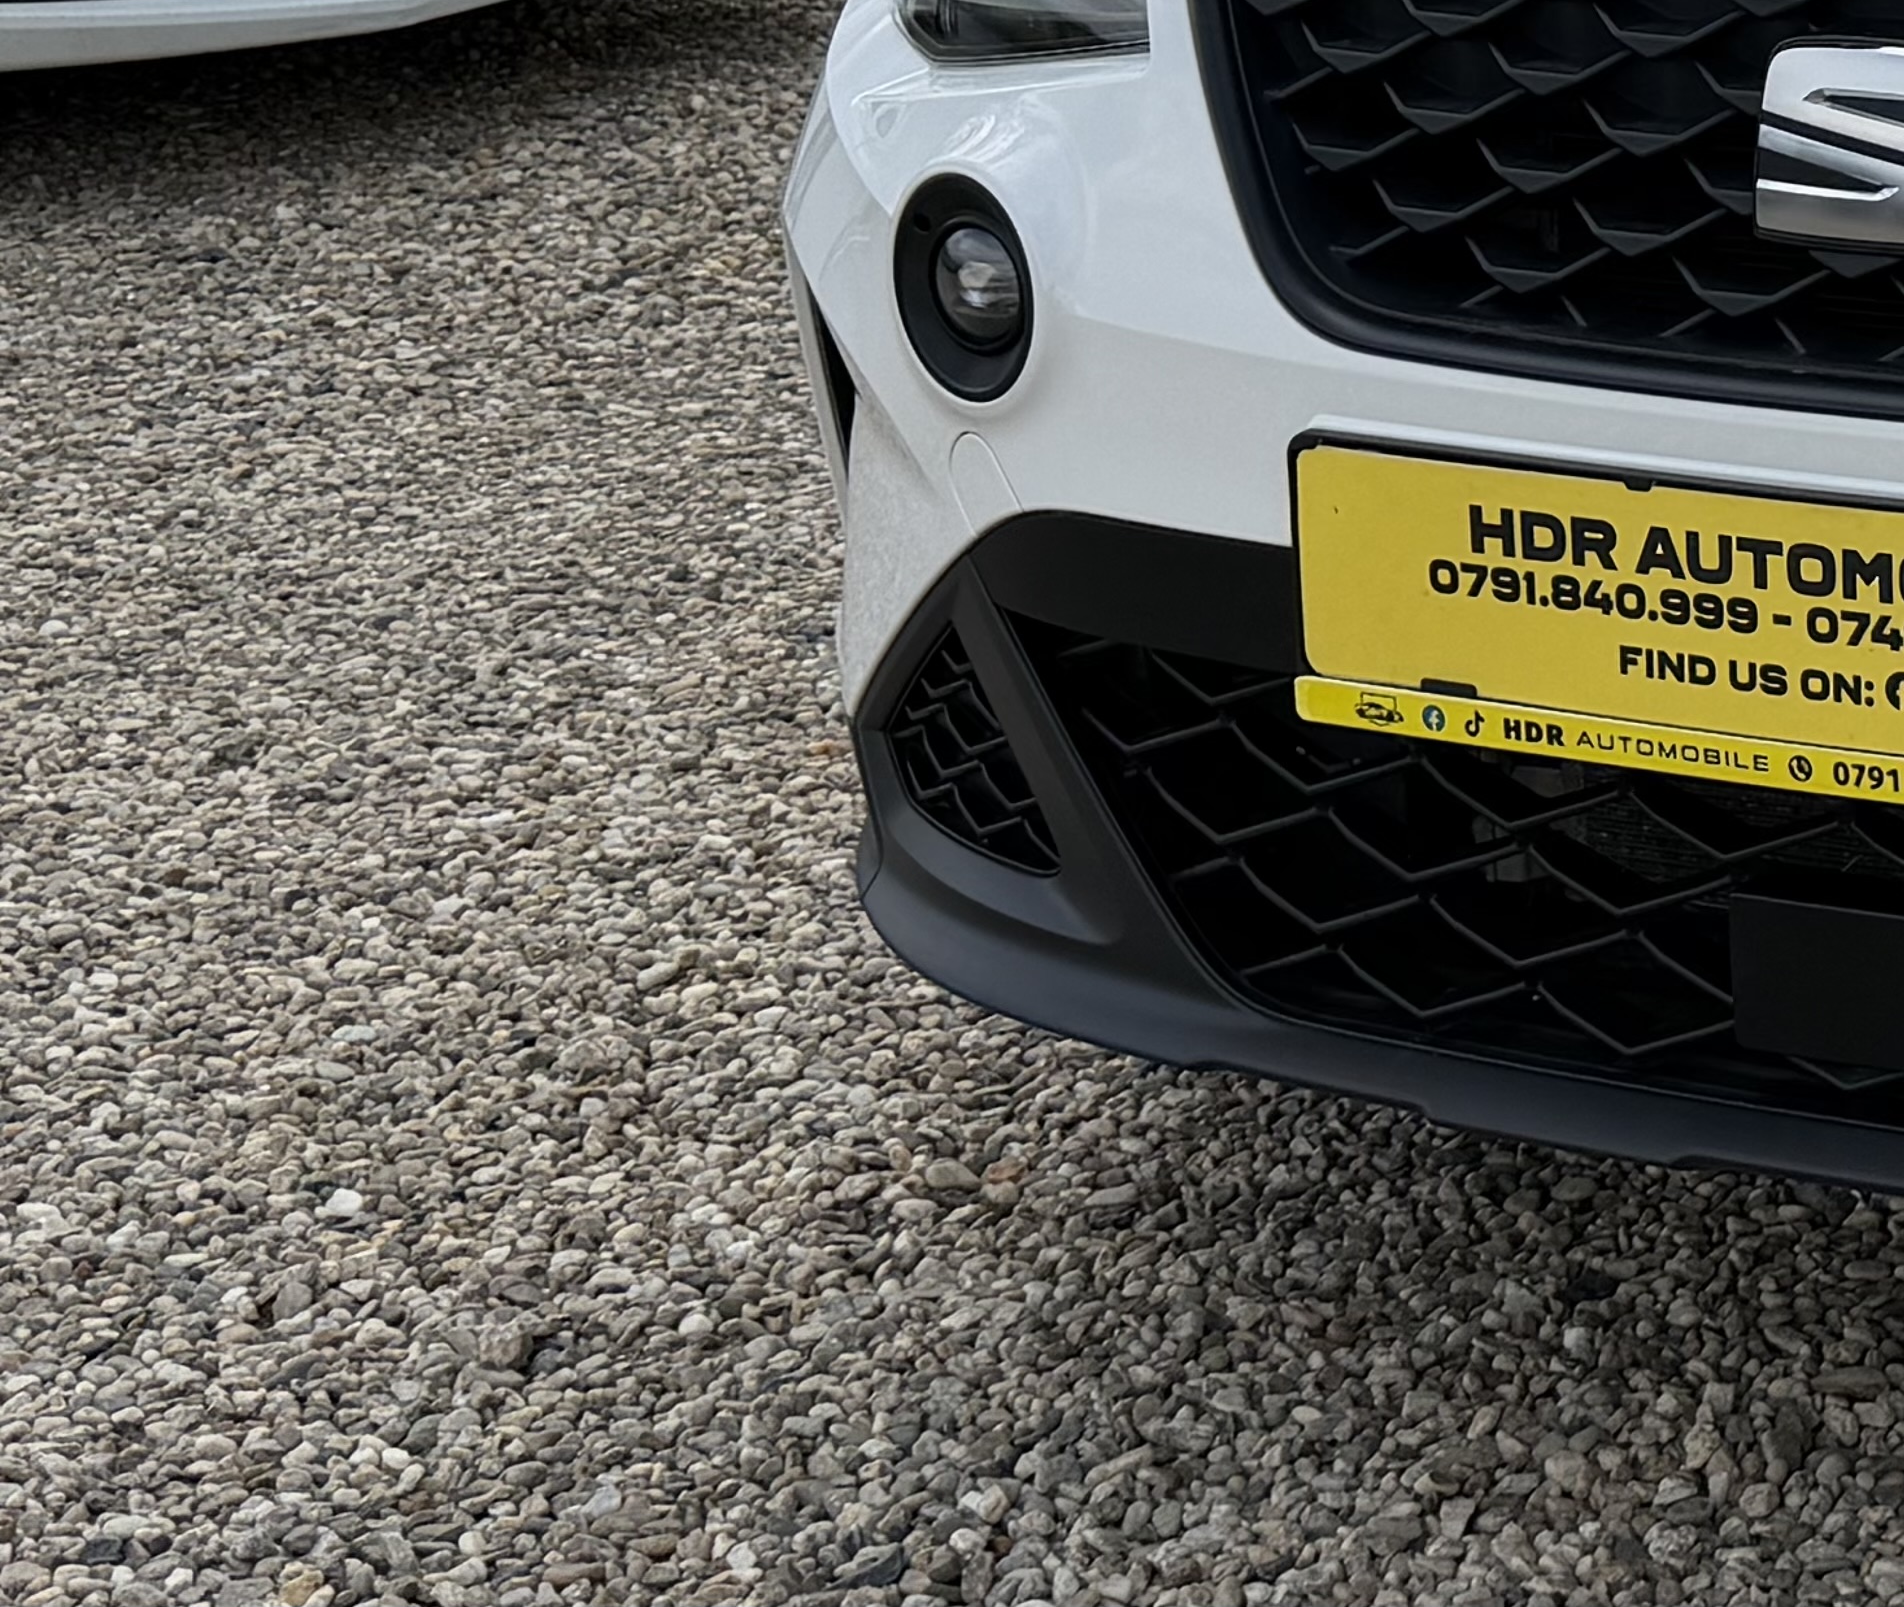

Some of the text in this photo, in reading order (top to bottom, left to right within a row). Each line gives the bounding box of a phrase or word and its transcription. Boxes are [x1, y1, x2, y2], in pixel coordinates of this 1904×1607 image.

[1469, 504, 1618, 571] HDR
[1429, 559, 1759, 634] 0791.840.999
[1619, 644, 1876, 706] FIND US ON:
[1503, 717, 1565, 746] HDR
[1576, 731, 1769, 772] AUTOMOBILE
[1832, 761, 1899, 792] 0791
